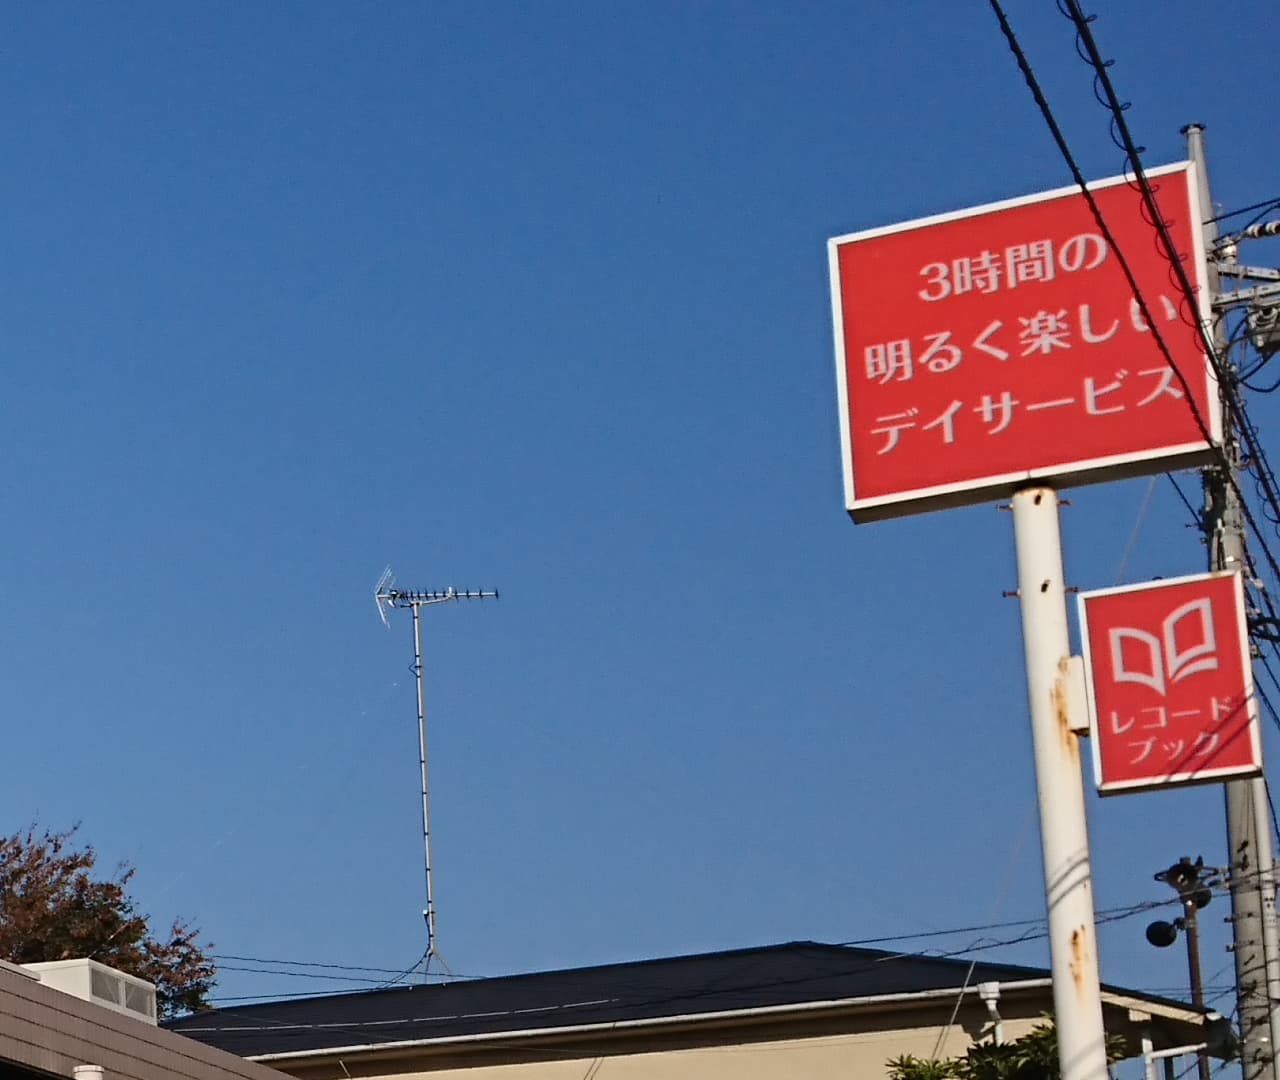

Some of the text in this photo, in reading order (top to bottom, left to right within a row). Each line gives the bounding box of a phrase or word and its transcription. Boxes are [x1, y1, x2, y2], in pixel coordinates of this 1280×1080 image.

[918, 232, 1110, 303] 3時間の
[865, 295, 1177, 387] 明るく楽しい
[870, 364, 1186, 456] デイサービス
[1111, 696, 1232, 735] レコード
[1128, 731, 1221, 765] ブック
